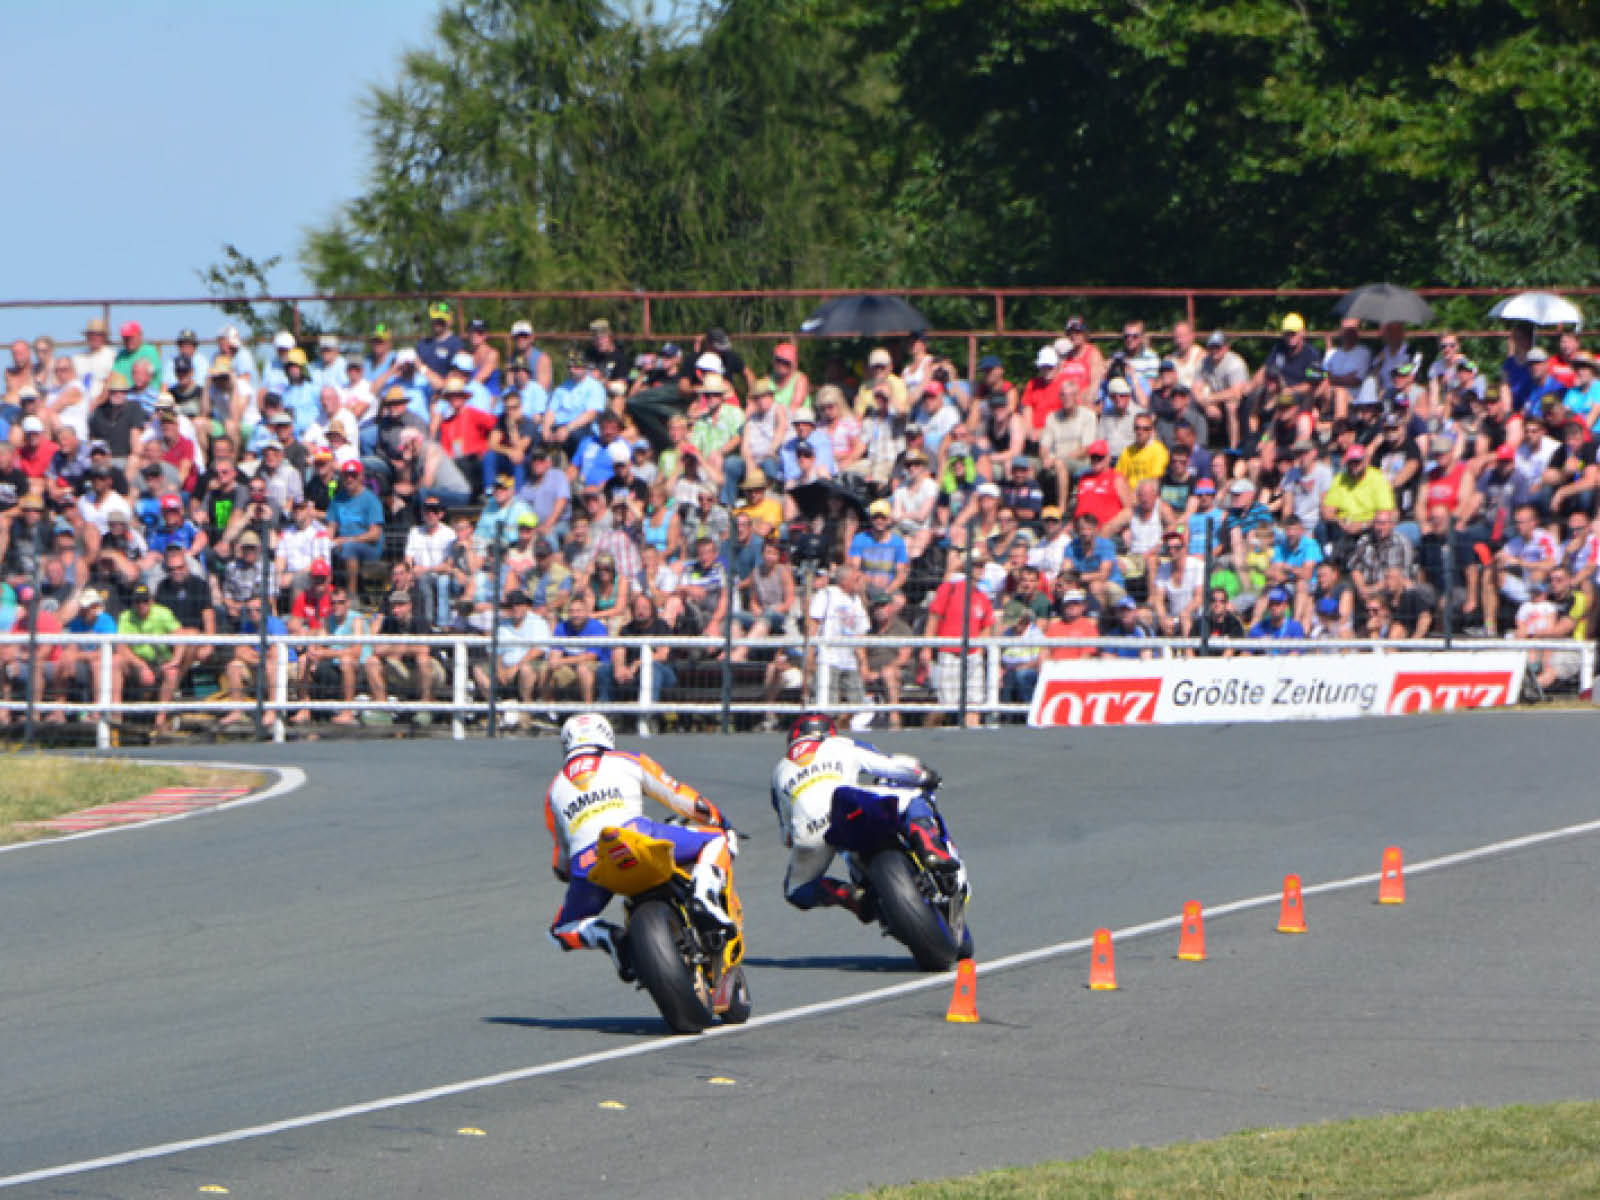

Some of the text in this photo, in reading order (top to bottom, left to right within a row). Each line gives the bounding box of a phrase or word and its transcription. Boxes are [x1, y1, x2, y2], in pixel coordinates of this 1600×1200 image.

[1040, 691, 1155, 724] OTZ
[1172, 678, 1265, 706] Größte
[1271, 677, 1379, 710] Zeitung
[562, 786, 624, 821] YAMAHA
